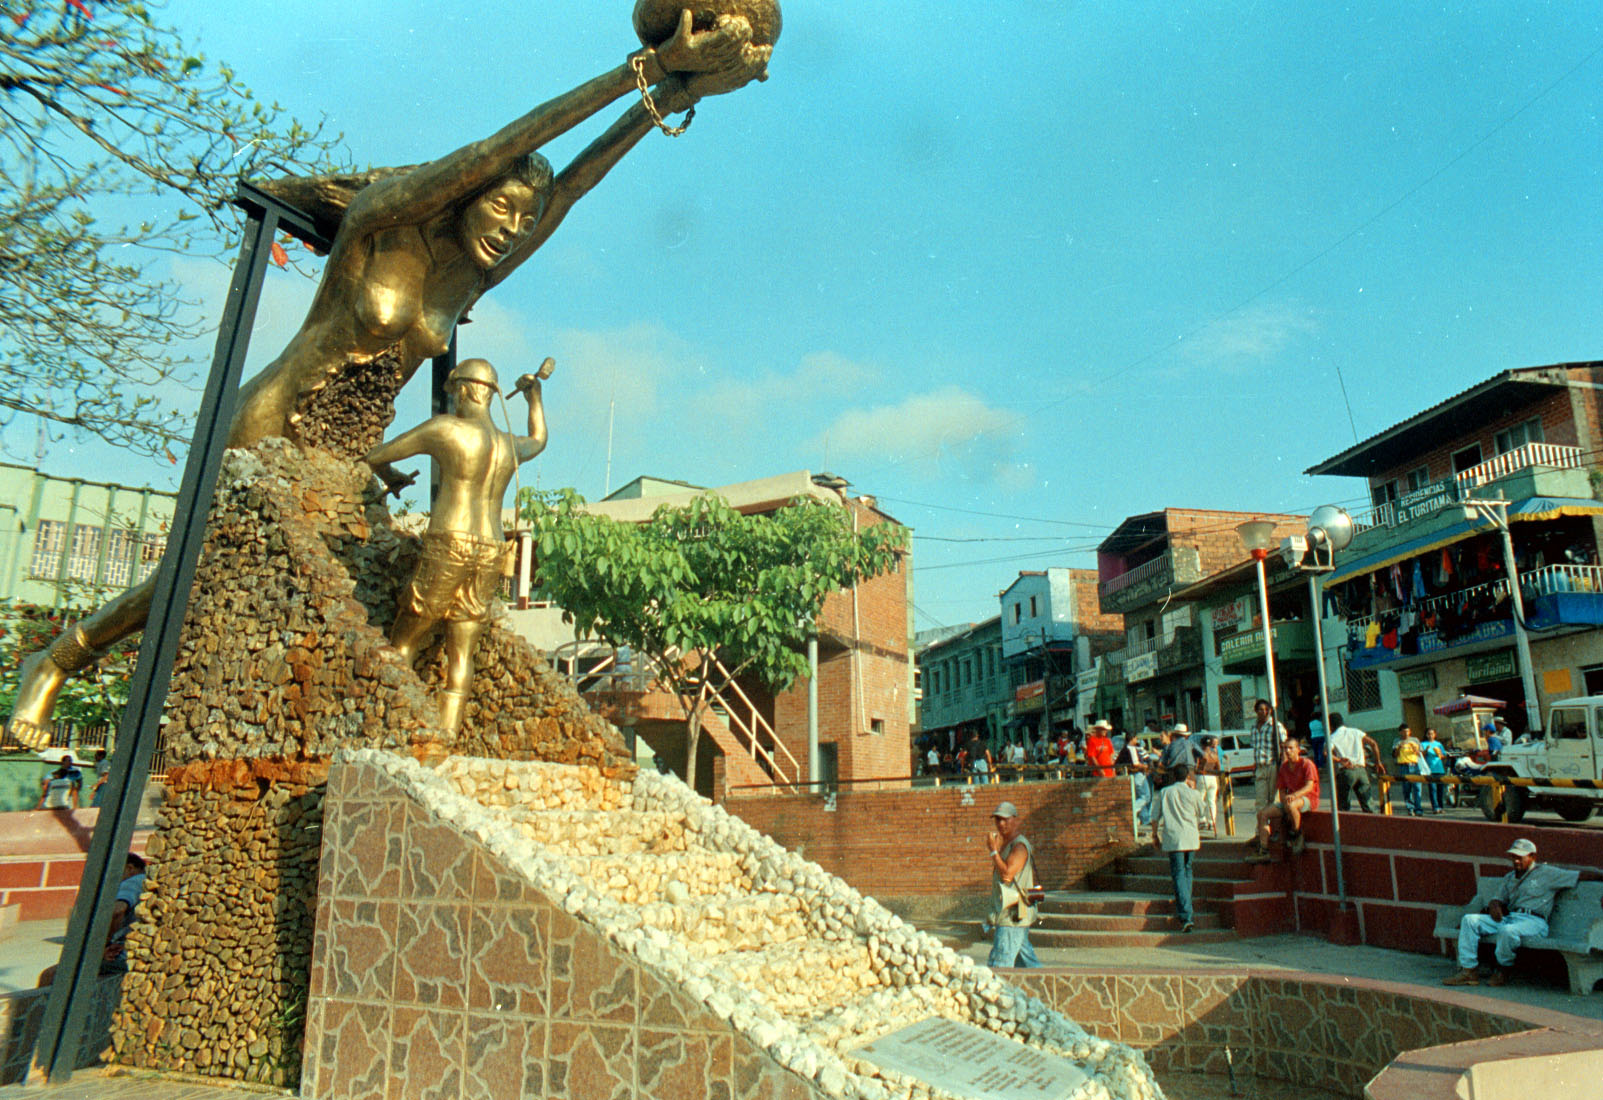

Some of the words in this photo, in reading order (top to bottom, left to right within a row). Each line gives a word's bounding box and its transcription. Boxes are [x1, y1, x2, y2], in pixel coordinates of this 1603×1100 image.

[1400, 480, 1446, 507] RESIDENCIAS
[1397, 510, 1409, 524] EL
[1221, 633, 1253, 652] GALERIA
